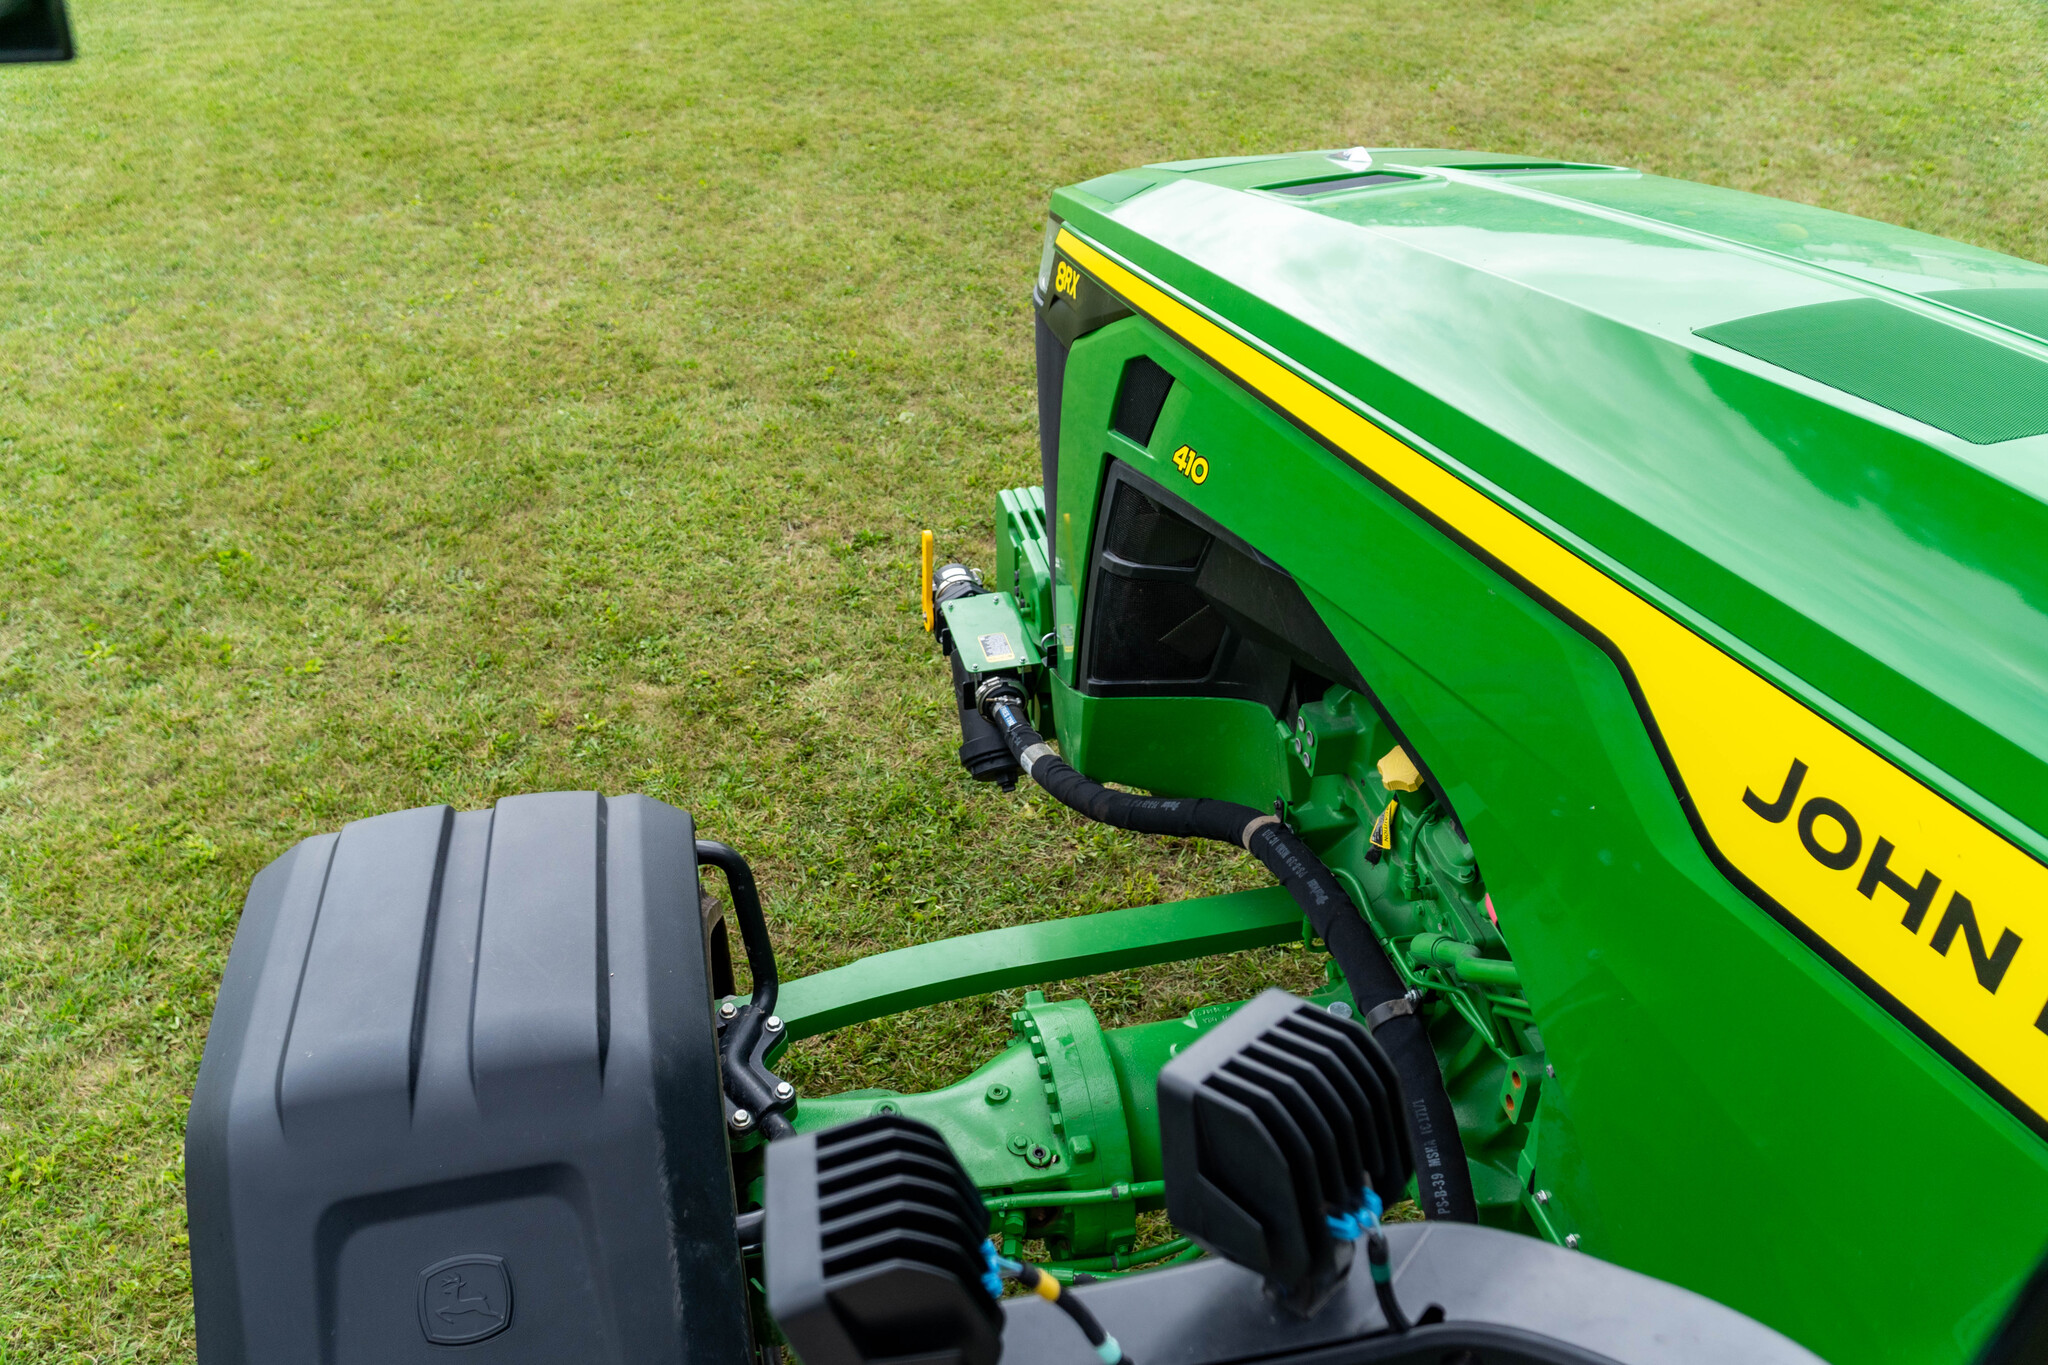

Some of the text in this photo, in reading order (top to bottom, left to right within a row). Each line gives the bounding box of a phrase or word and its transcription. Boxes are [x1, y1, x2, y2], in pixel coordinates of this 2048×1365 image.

[1055, 261, 1080, 300] 8RX
[1172, 444, 1210, 486] 410
[1741, 757, 2024, 996] JOHN
[1431, 1172, 1451, 1215] PS-B-39
